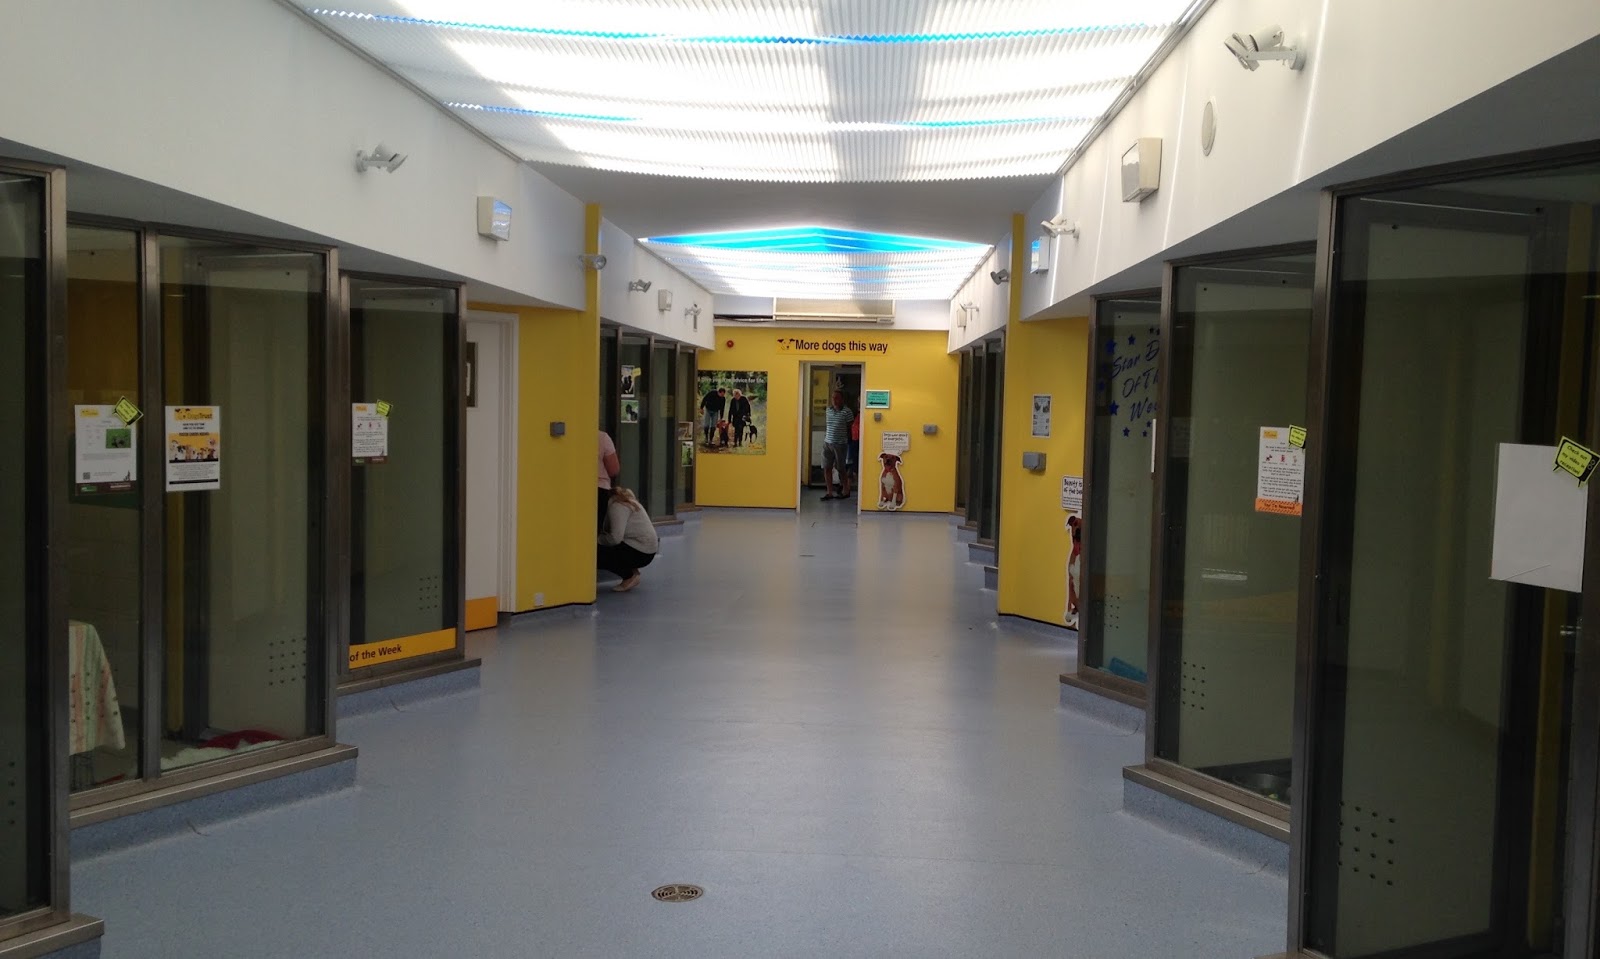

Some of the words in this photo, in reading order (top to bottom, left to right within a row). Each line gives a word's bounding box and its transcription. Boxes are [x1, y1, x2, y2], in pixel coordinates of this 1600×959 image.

[795, 339, 820, 351] More
[822, 340, 846, 354] dogs
[849, 340, 867, 351] this
[869, 343, 888, 354] way
[1110, 354, 1141, 379] Star
[1145, 339, 1160, 362] D
[1122, 375, 1141, 399] Of
[1142, 366, 1160, 390] Th
[350, 651, 359, 662] of
[361, 650, 376, 660] the
[378, 643, 402, 656] Week
